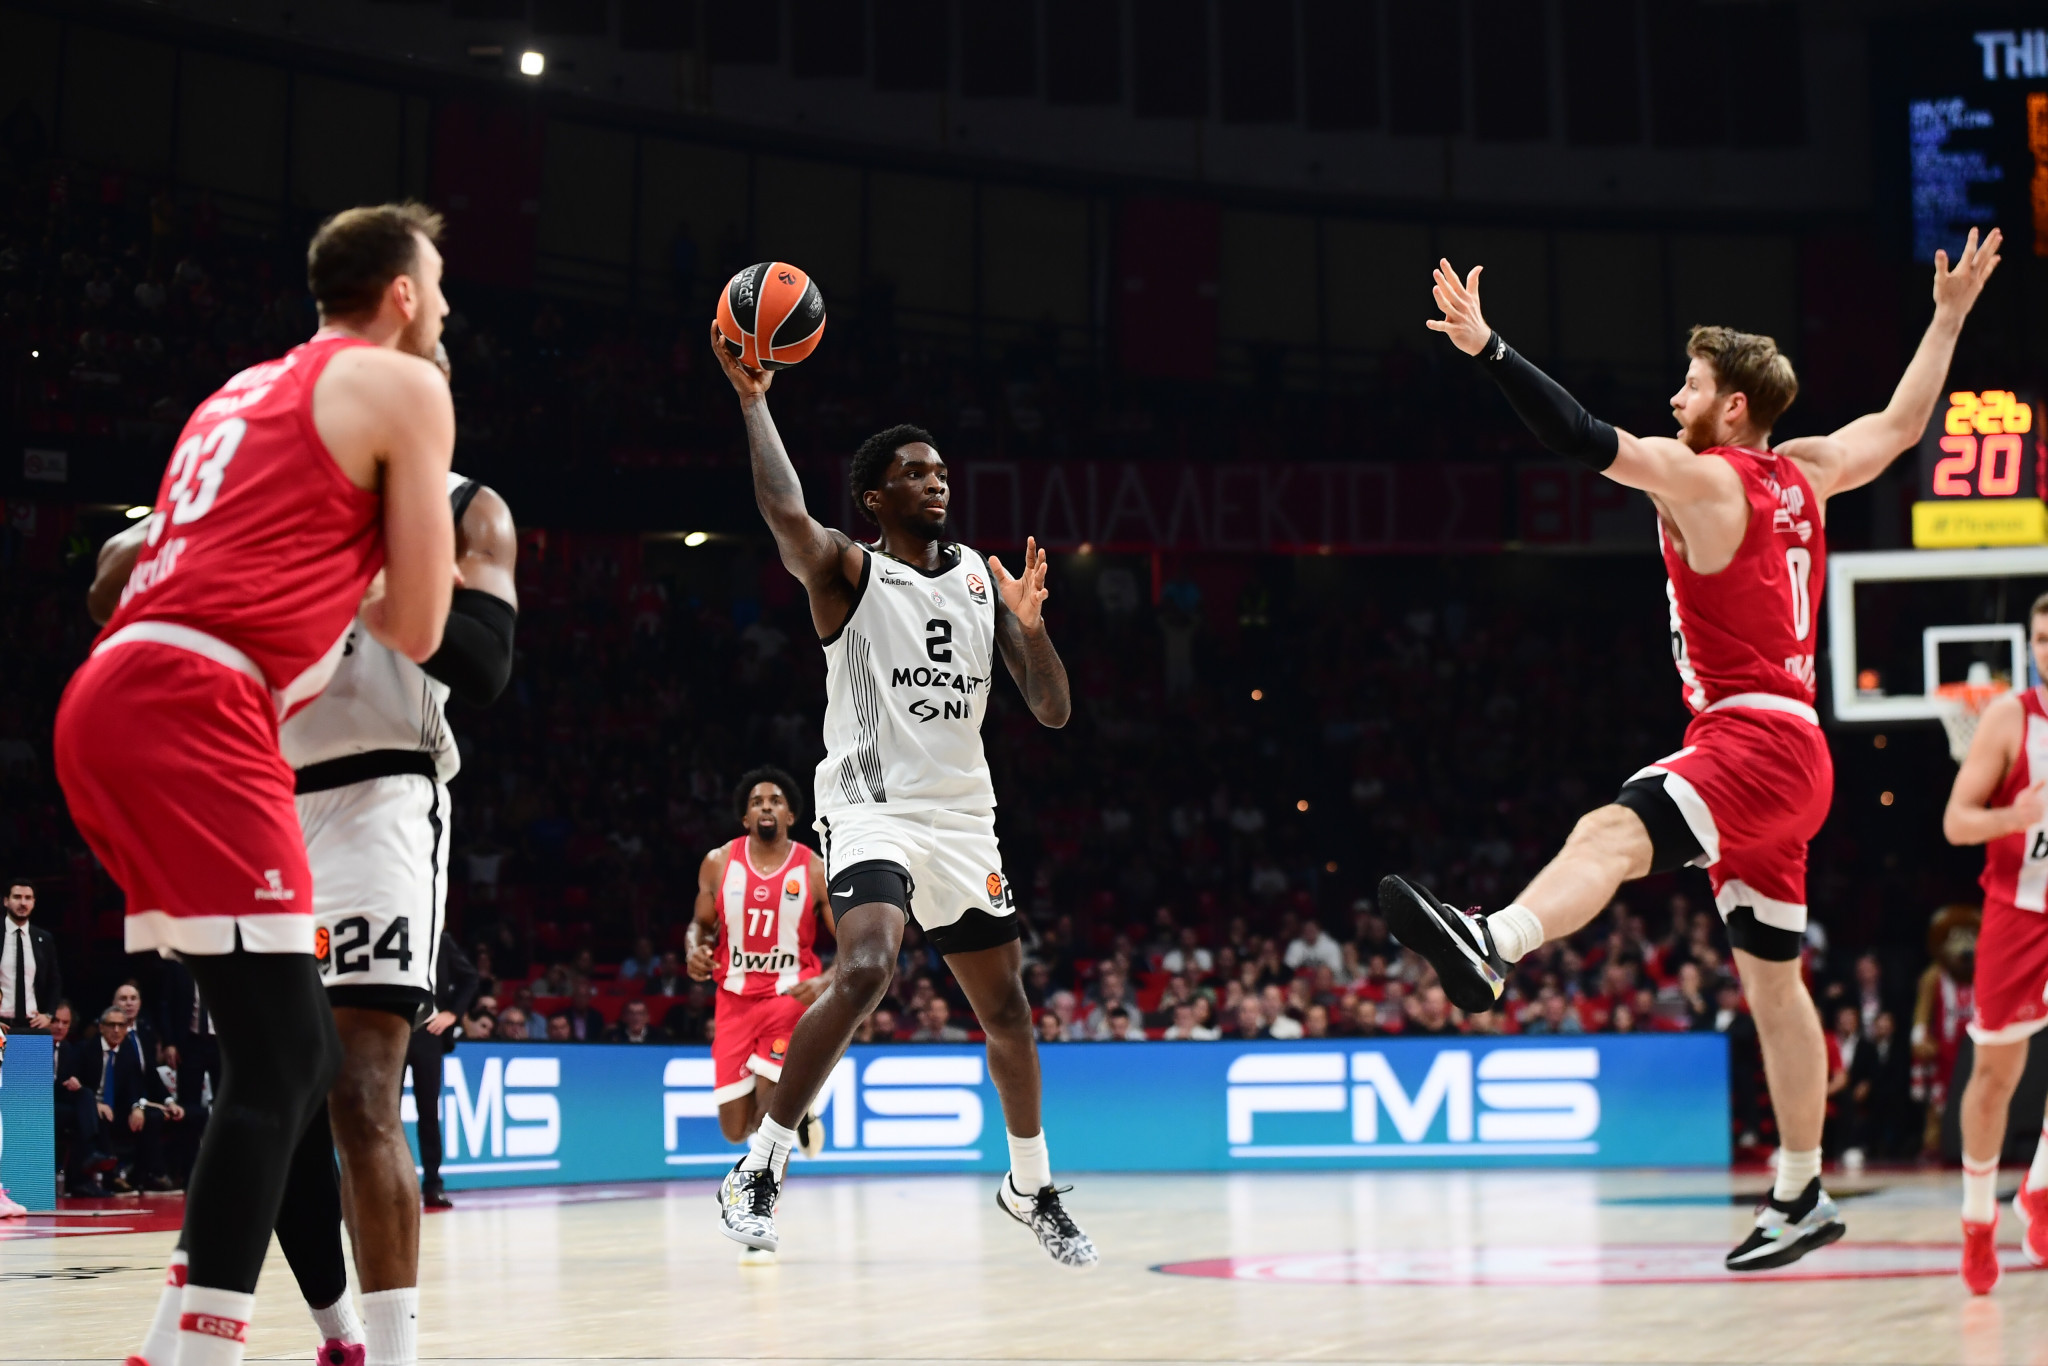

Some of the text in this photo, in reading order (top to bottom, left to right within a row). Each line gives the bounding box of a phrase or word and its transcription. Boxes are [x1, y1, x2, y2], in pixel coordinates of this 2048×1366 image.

[1973, 30, 2048, 80] THI
[1933, 434, 2023, 496] 20
[884, 578, 914, 587] AikBank
[1786, 547, 1812, 641] 0
[925, 618, 953, 664] 2
[943, 700, 970, 720] NI
[333, 915, 413, 973] 24
[747, 908, 775, 938] 77
[732, 946, 795, 972] bwin
[1226, 1047, 1601, 1143] FMS
